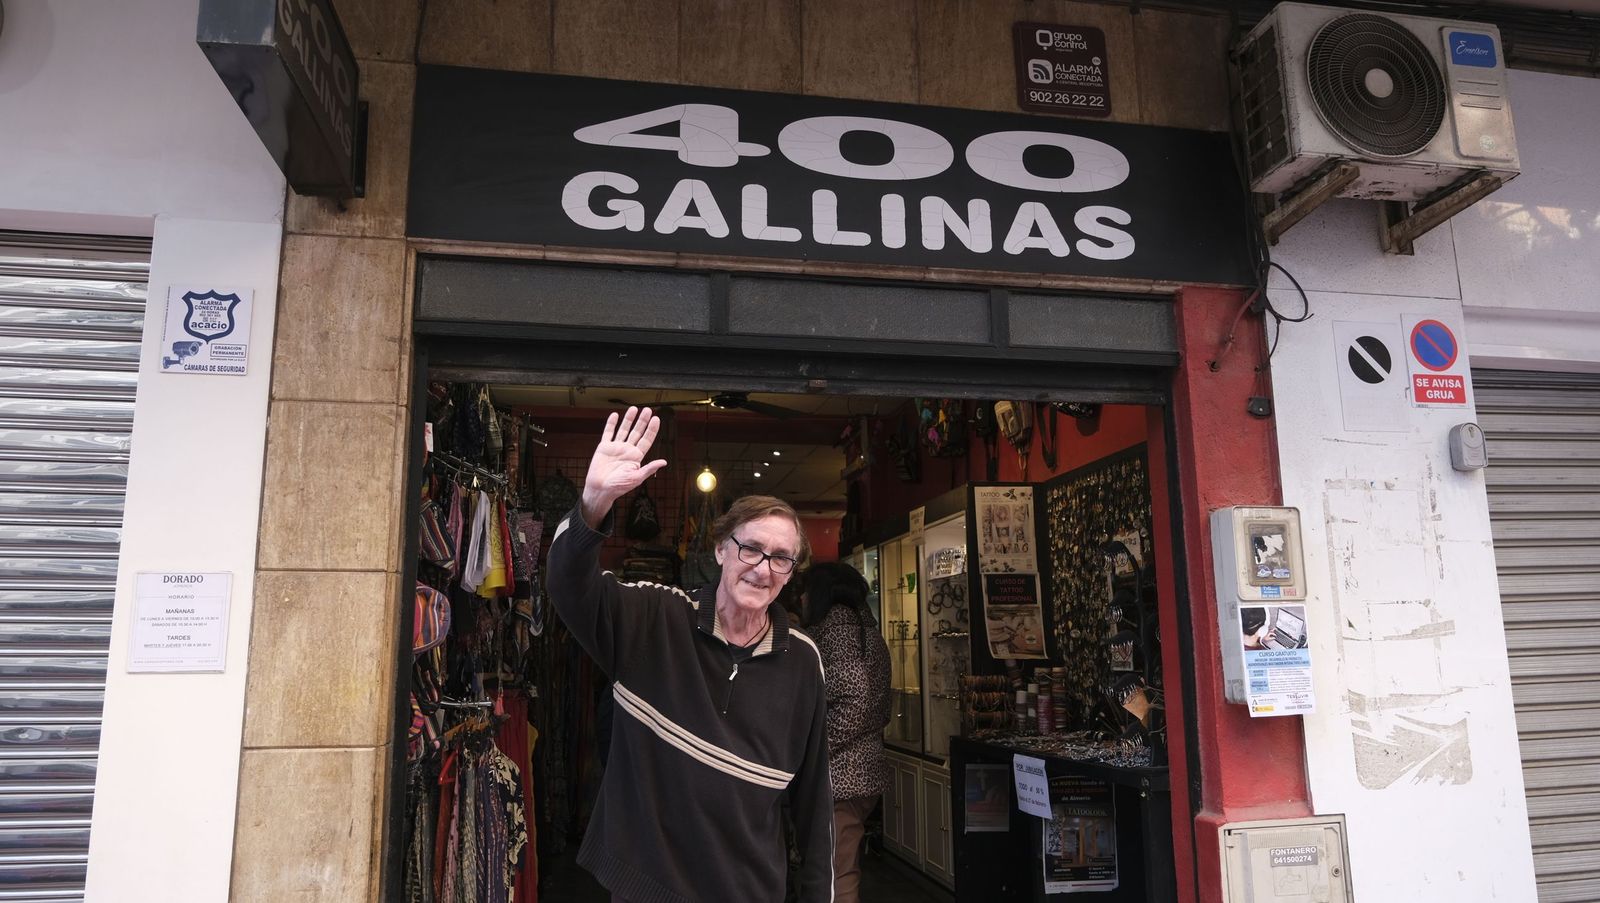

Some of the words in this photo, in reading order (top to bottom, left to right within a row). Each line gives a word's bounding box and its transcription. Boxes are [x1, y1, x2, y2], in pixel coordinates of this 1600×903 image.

[1053, 31, 1083, 41] grupo
[1054, 40, 1088, 50] control
[1054, 63, 1102, 75] ALARMA
[1055, 73, 1103, 83] CONECTADA
[1030, 91, 1053, 103] 902
[1055, 93, 1070, 104] 26
[1072, 94, 1087, 106] 22
[1089, 96, 1105, 107] 22
[573, 103, 1131, 193] 400
[561, 171, 1136, 260] GALLINAS
[191, 321, 228, 330] acacio
[217, 365, 246, 373] SEGURIDAD
[1416, 378, 1429, 388] SE
[1432, 379, 1462, 388] AVISA
[1426, 390, 1455, 400] GRUA
[162, 575, 204, 584] DORADO
[1270, 847, 1317, 855] FONTANERO
[1274, 855, 1312, 864] 641500274
